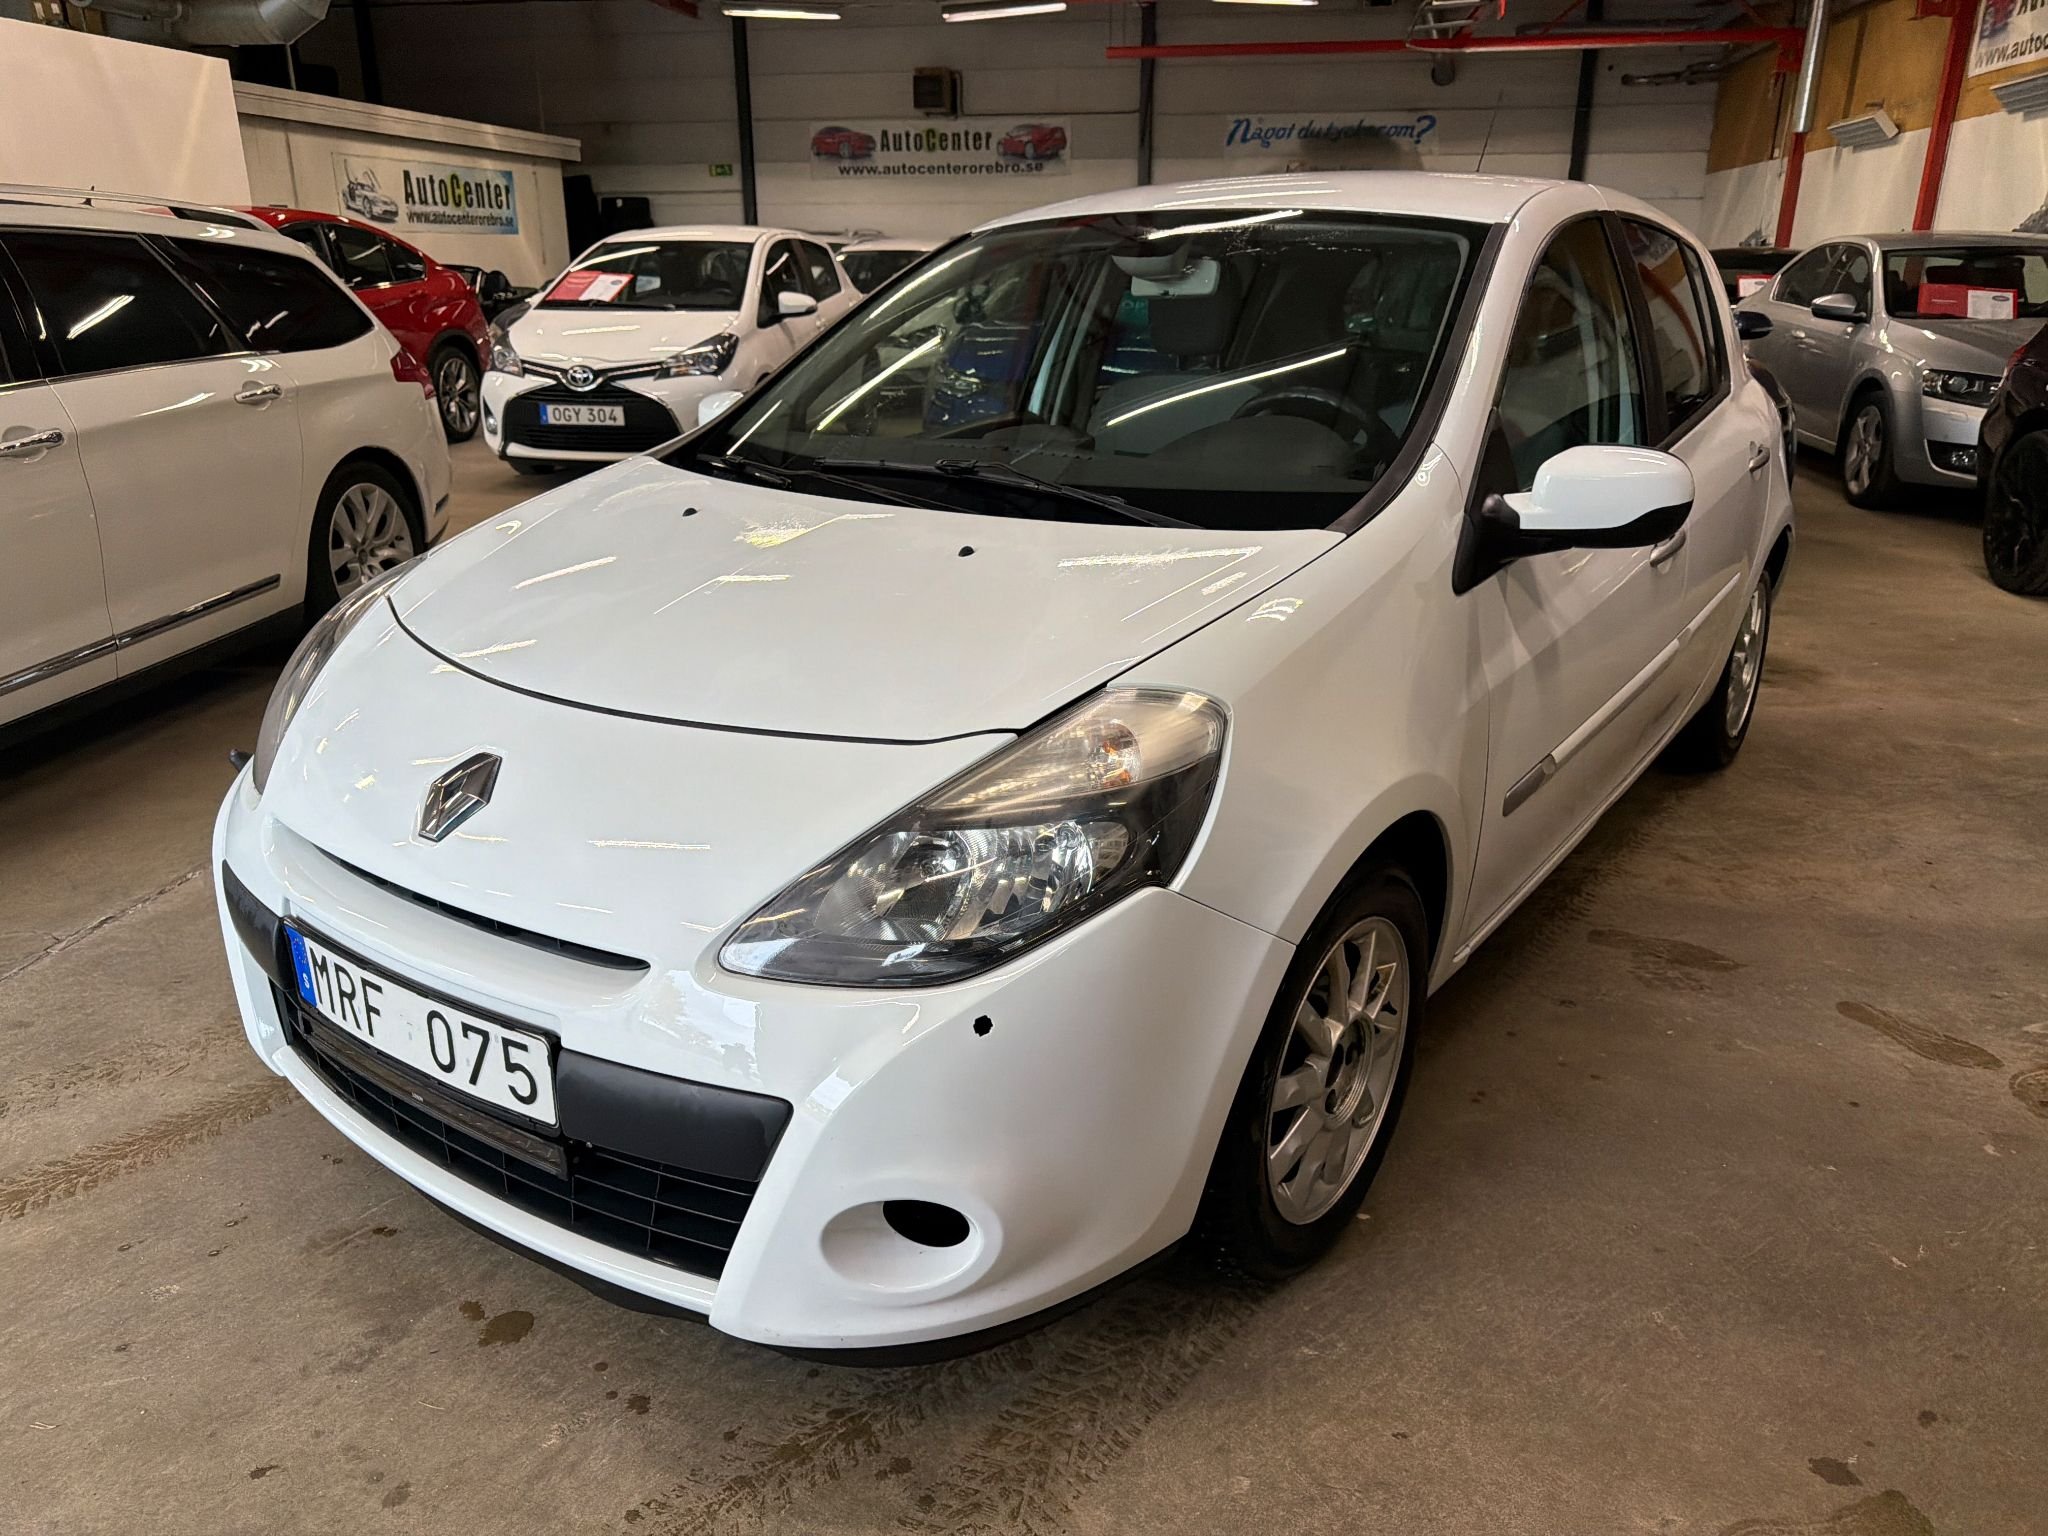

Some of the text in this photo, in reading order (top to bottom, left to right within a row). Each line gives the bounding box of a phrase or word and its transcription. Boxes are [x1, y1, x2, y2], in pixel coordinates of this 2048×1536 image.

[880, 128, 993, 152] AutoCenter
[838, 160, 1044, 176] www.autocenterorebro.se
[403, 169, 511, 210] AutoCenter
[406, 208, 514, 227] www.autocenterorebro.se
[552, 407, 581, 422] OGY
[587, 408, 617, 423] 304
[302, 973, 311, 989] S
[309, 946, 538, 1105] MRF 075
